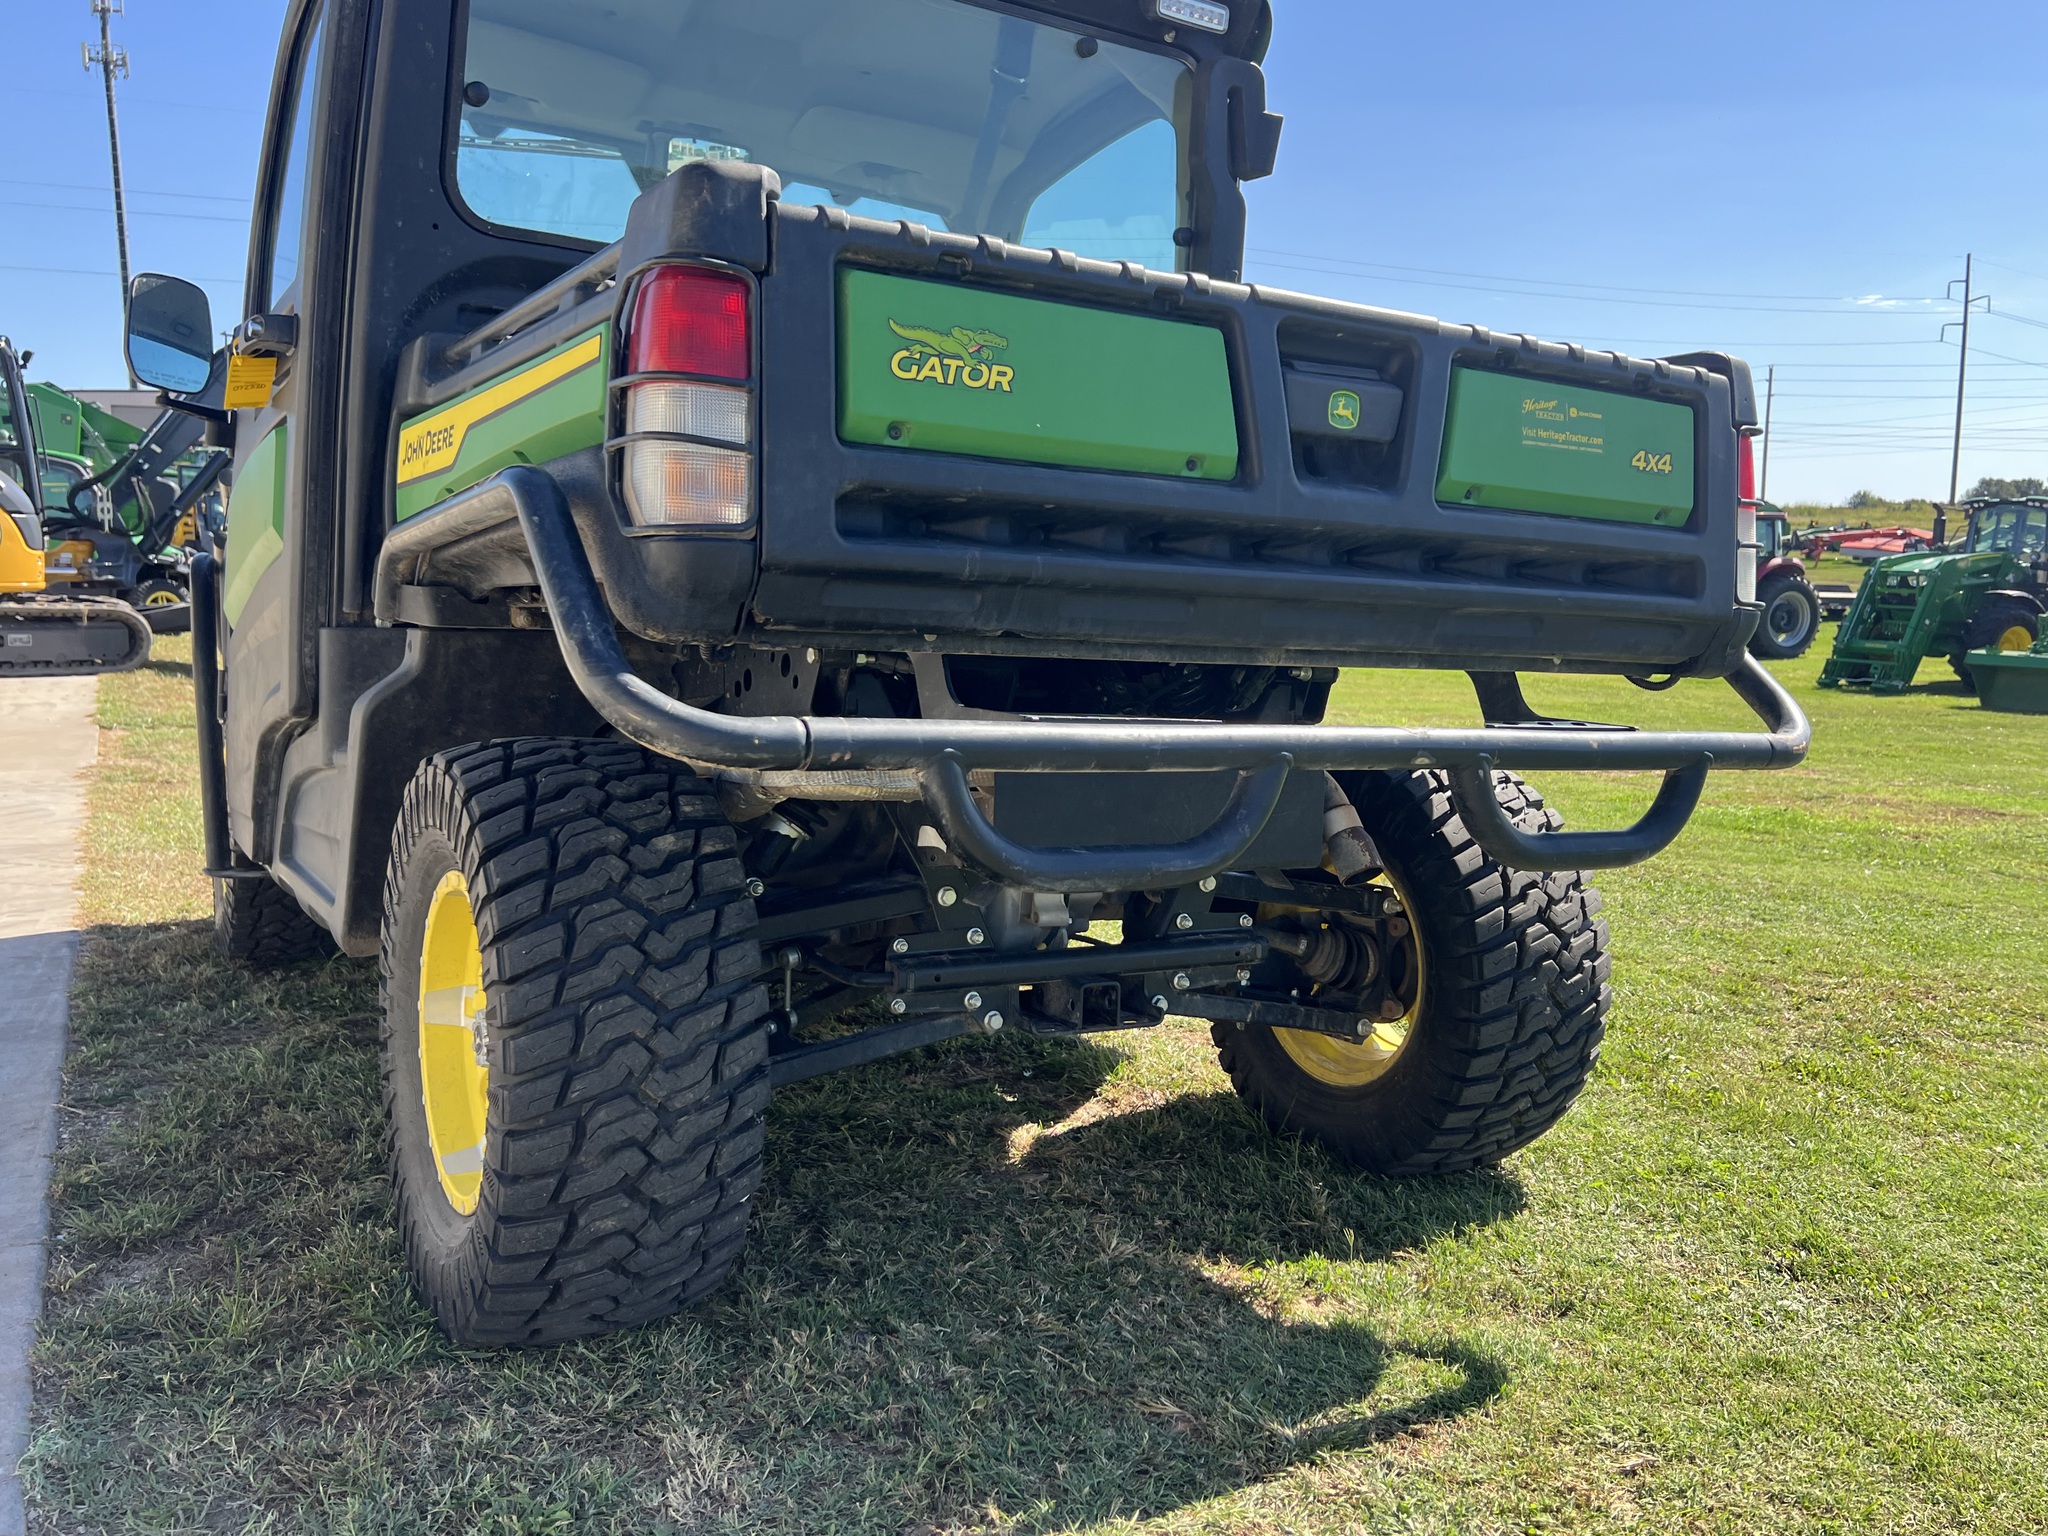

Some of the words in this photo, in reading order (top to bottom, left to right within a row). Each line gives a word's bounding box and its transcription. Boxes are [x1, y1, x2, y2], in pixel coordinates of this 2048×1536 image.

[890, 349, 1015, 393] GATOR
[1522, 398, 1558, 413] Heritage
[402, 436, 426, 466] JOHN
[425, 424, 455, 457] DEERE
[1522, 426, 1538, 438] Visit
[1538, 428, 1603, 445] HeritageTractor.com
